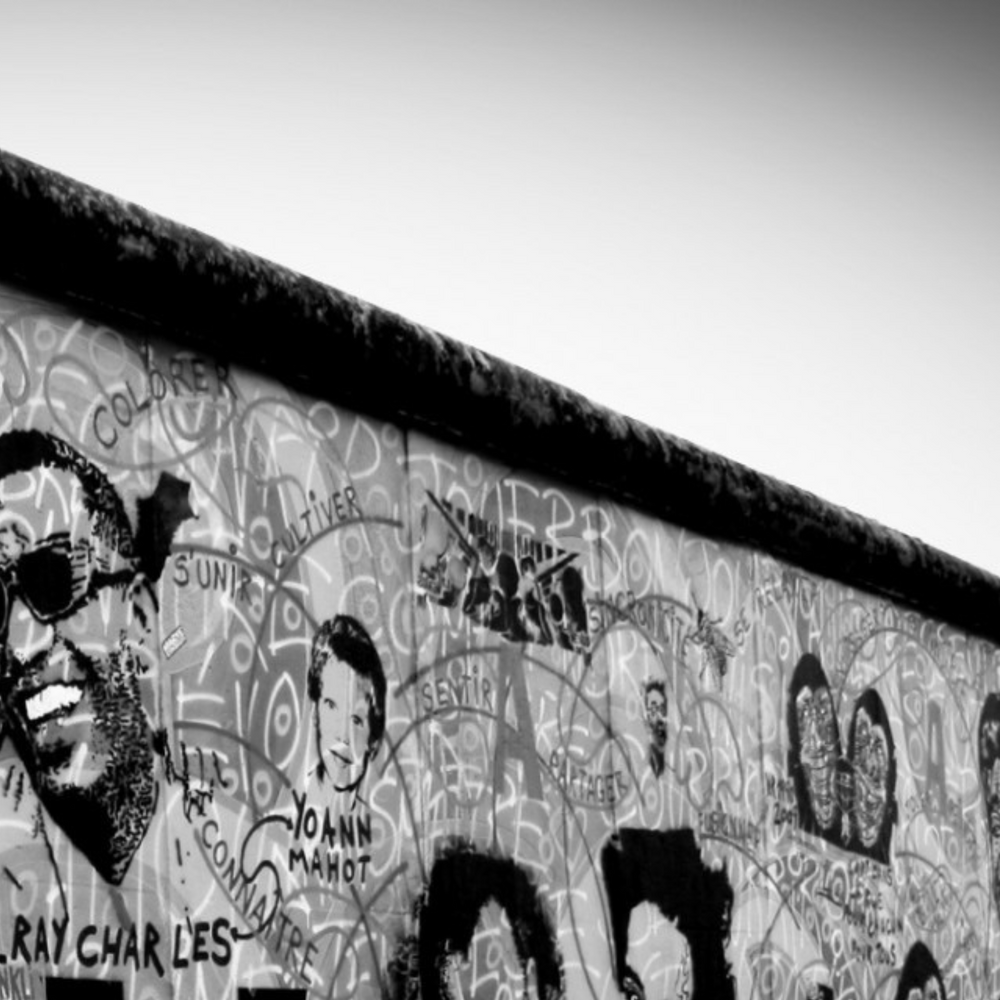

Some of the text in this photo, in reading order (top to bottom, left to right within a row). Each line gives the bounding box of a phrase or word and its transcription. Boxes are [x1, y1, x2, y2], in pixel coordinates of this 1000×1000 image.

[93, 355, 238, 448] COLORER
[271, 486, 362, 569] CULTIVER
[421, 664, 494, 713] SENTIR
[292, 788, 372, 850] YOANN
[289, 847, 372, 884] MAHOT
